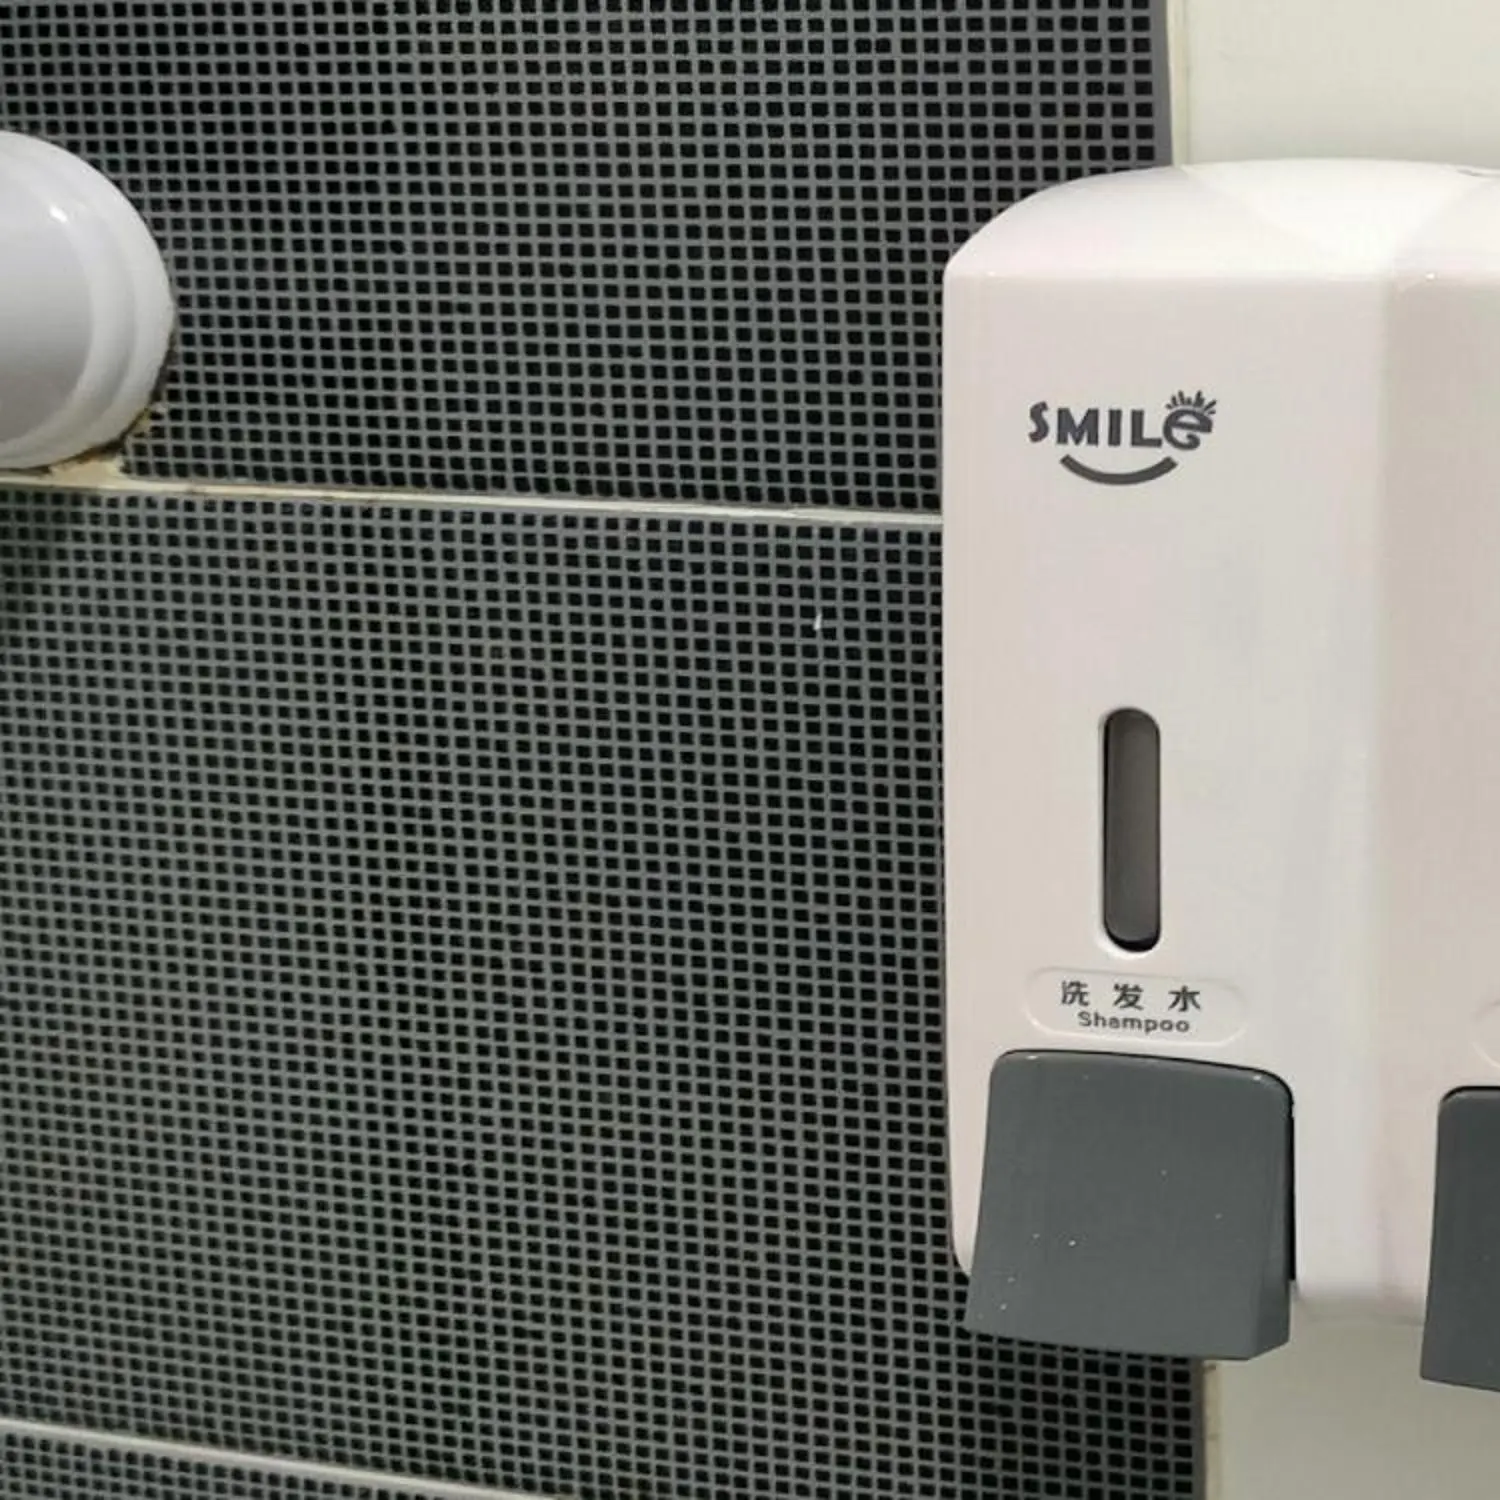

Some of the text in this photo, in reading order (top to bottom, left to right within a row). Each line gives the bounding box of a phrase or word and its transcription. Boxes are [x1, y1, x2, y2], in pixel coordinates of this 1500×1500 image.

[1060, 980, 1202, 1013] 洗发水
[1078, 1010, 1190, 1033] Shampoo
